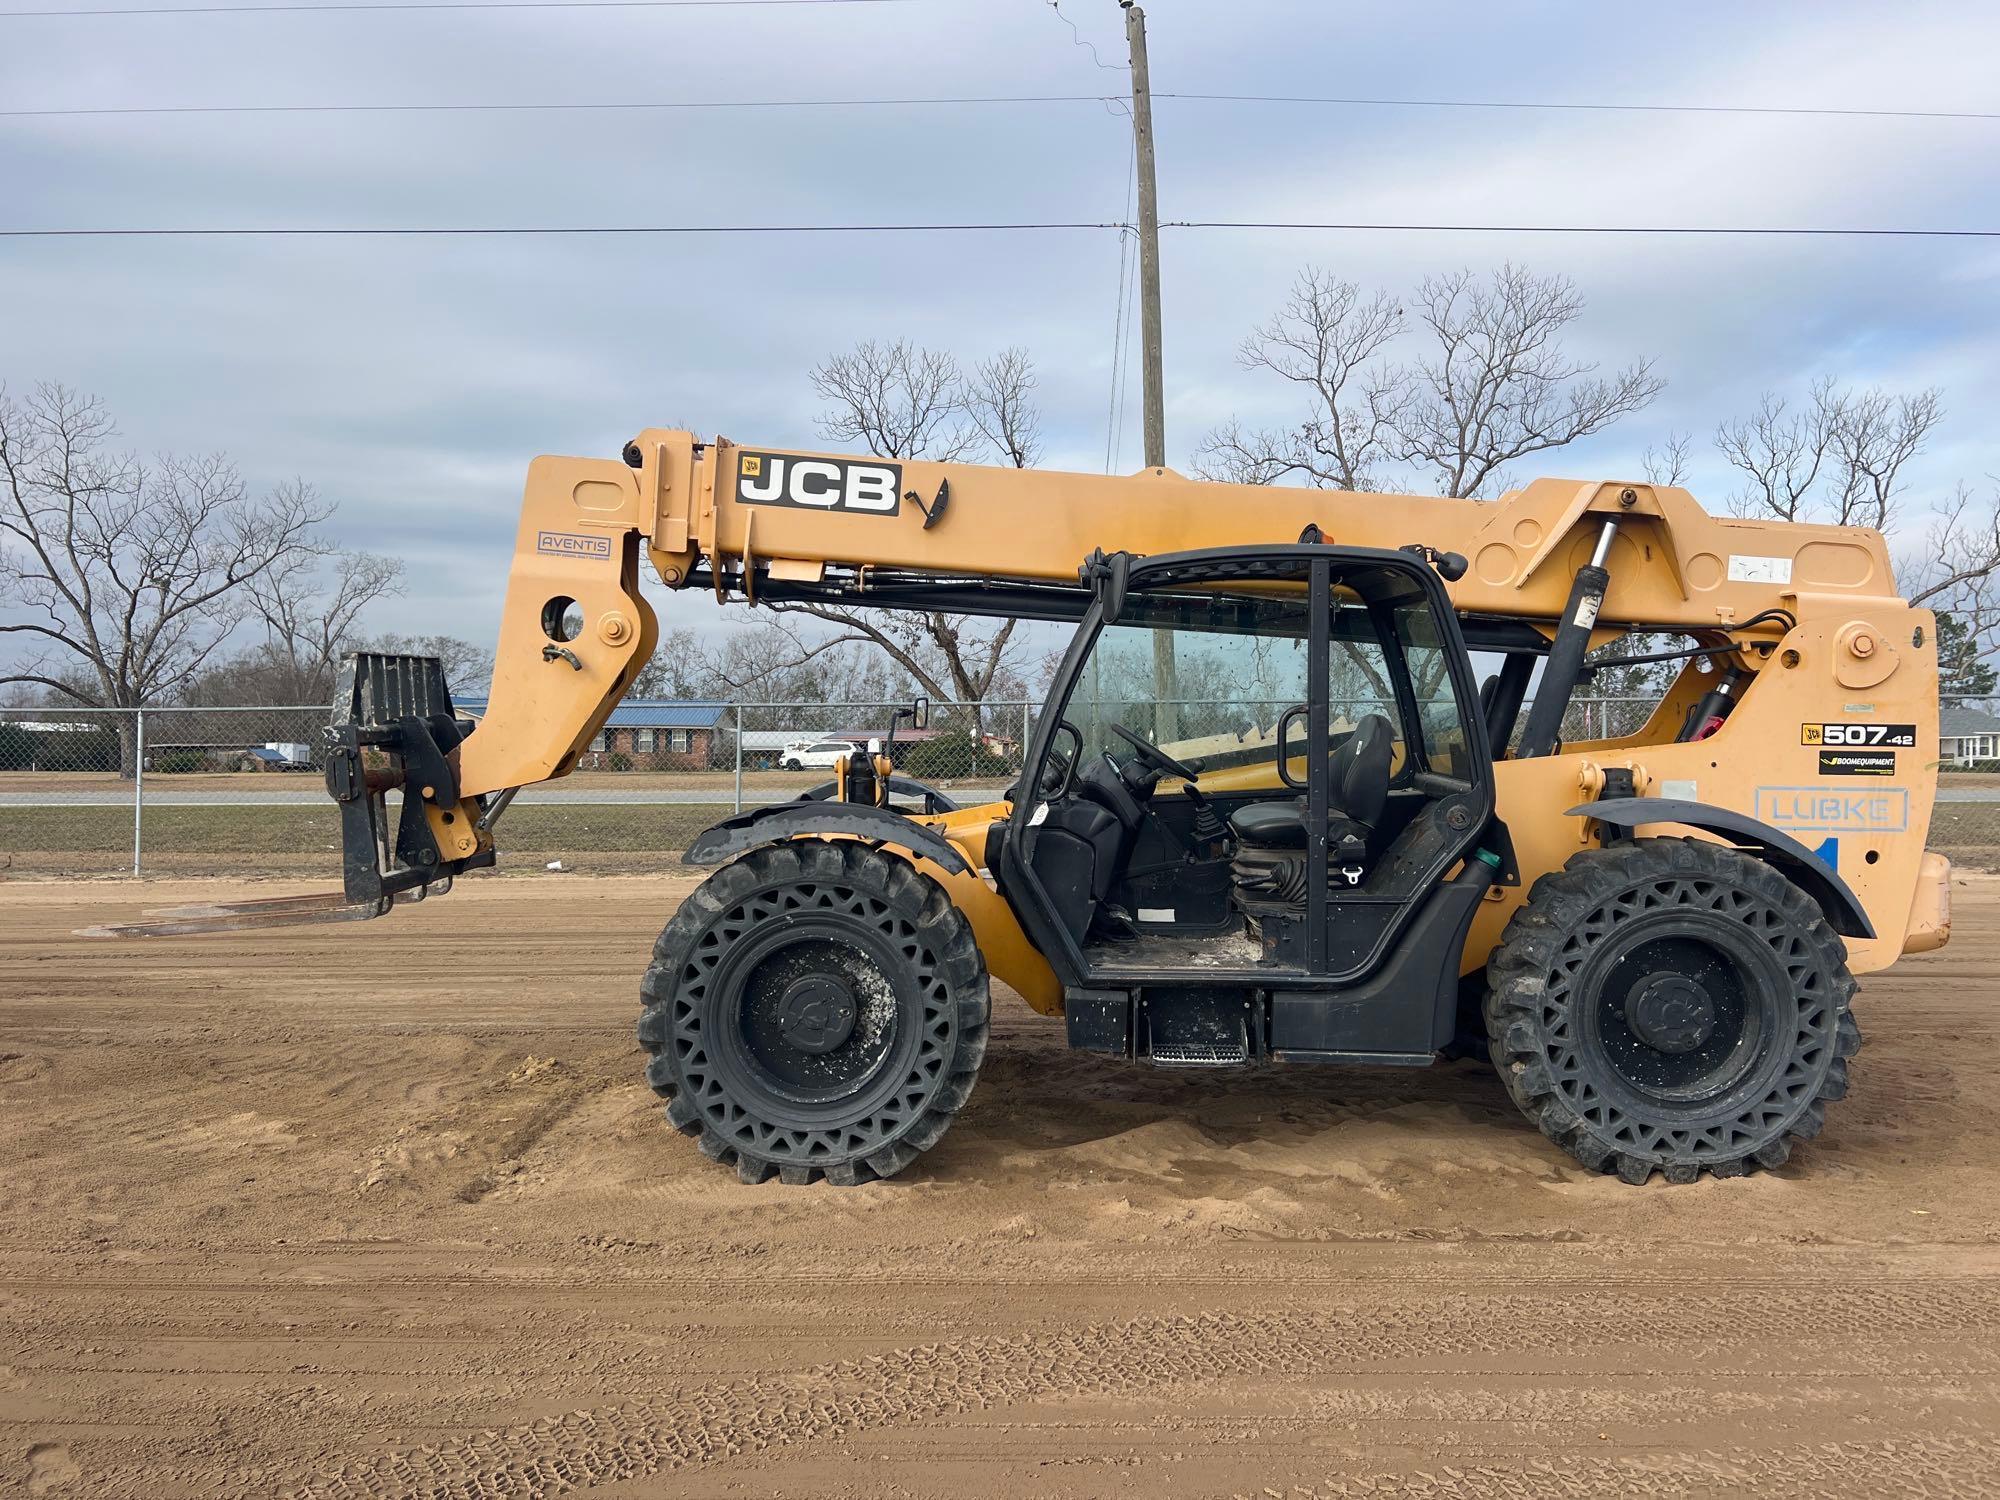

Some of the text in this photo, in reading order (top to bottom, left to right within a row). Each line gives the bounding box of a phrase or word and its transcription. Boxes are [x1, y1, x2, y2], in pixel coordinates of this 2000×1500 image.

[740, 458, 896, 511] JCB
[542, 536, 607, 552] AVENTIS
[1806, 728, 1821, 741] JCB
[1836, 757, 1894, 767] BOOMEQUIPMENT
[1773, 798, 1889, 820] LUBKE
